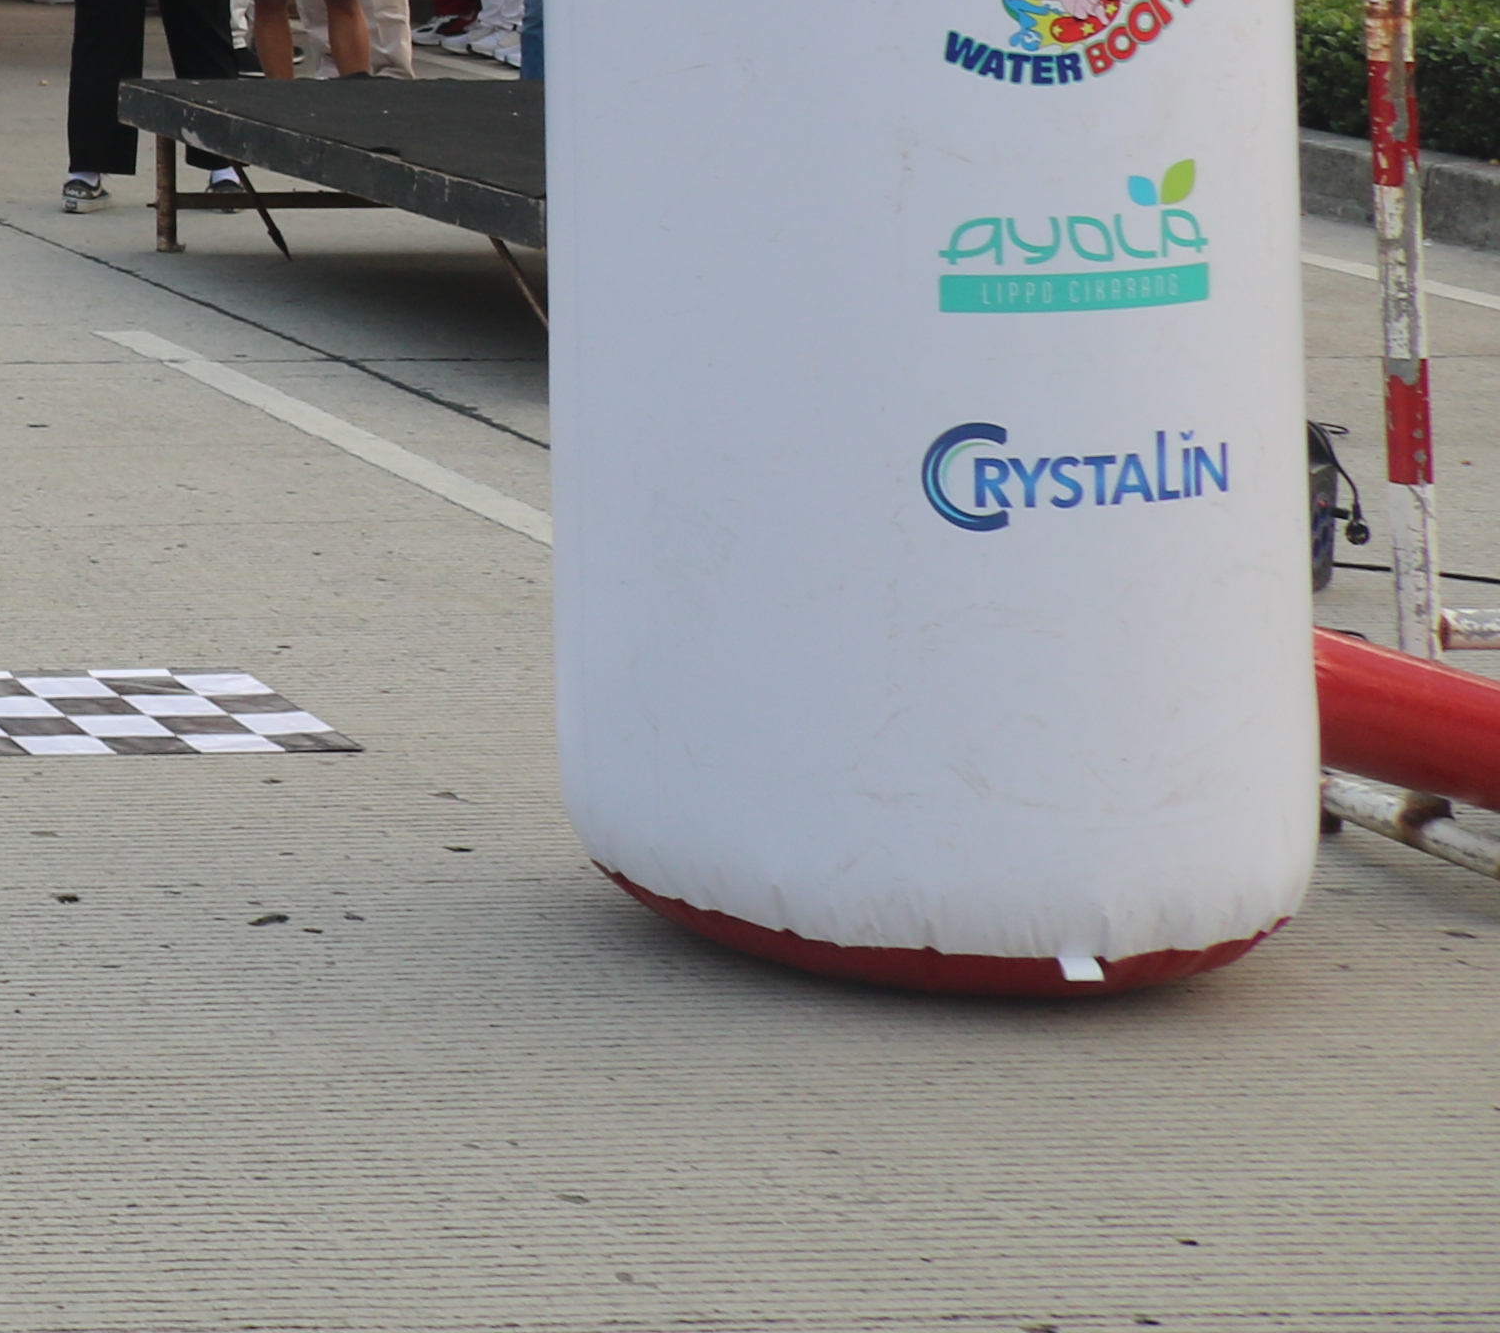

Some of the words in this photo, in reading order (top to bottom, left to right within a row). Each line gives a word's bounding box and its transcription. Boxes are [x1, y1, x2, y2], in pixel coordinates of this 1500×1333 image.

[942, 29, 1084, 86] WATER
[938, 207, 1208, 265] AYOLA
[981, 281, 1053, 306] LIPPO
[1068, 273, 1179, 302] CIKARANG
